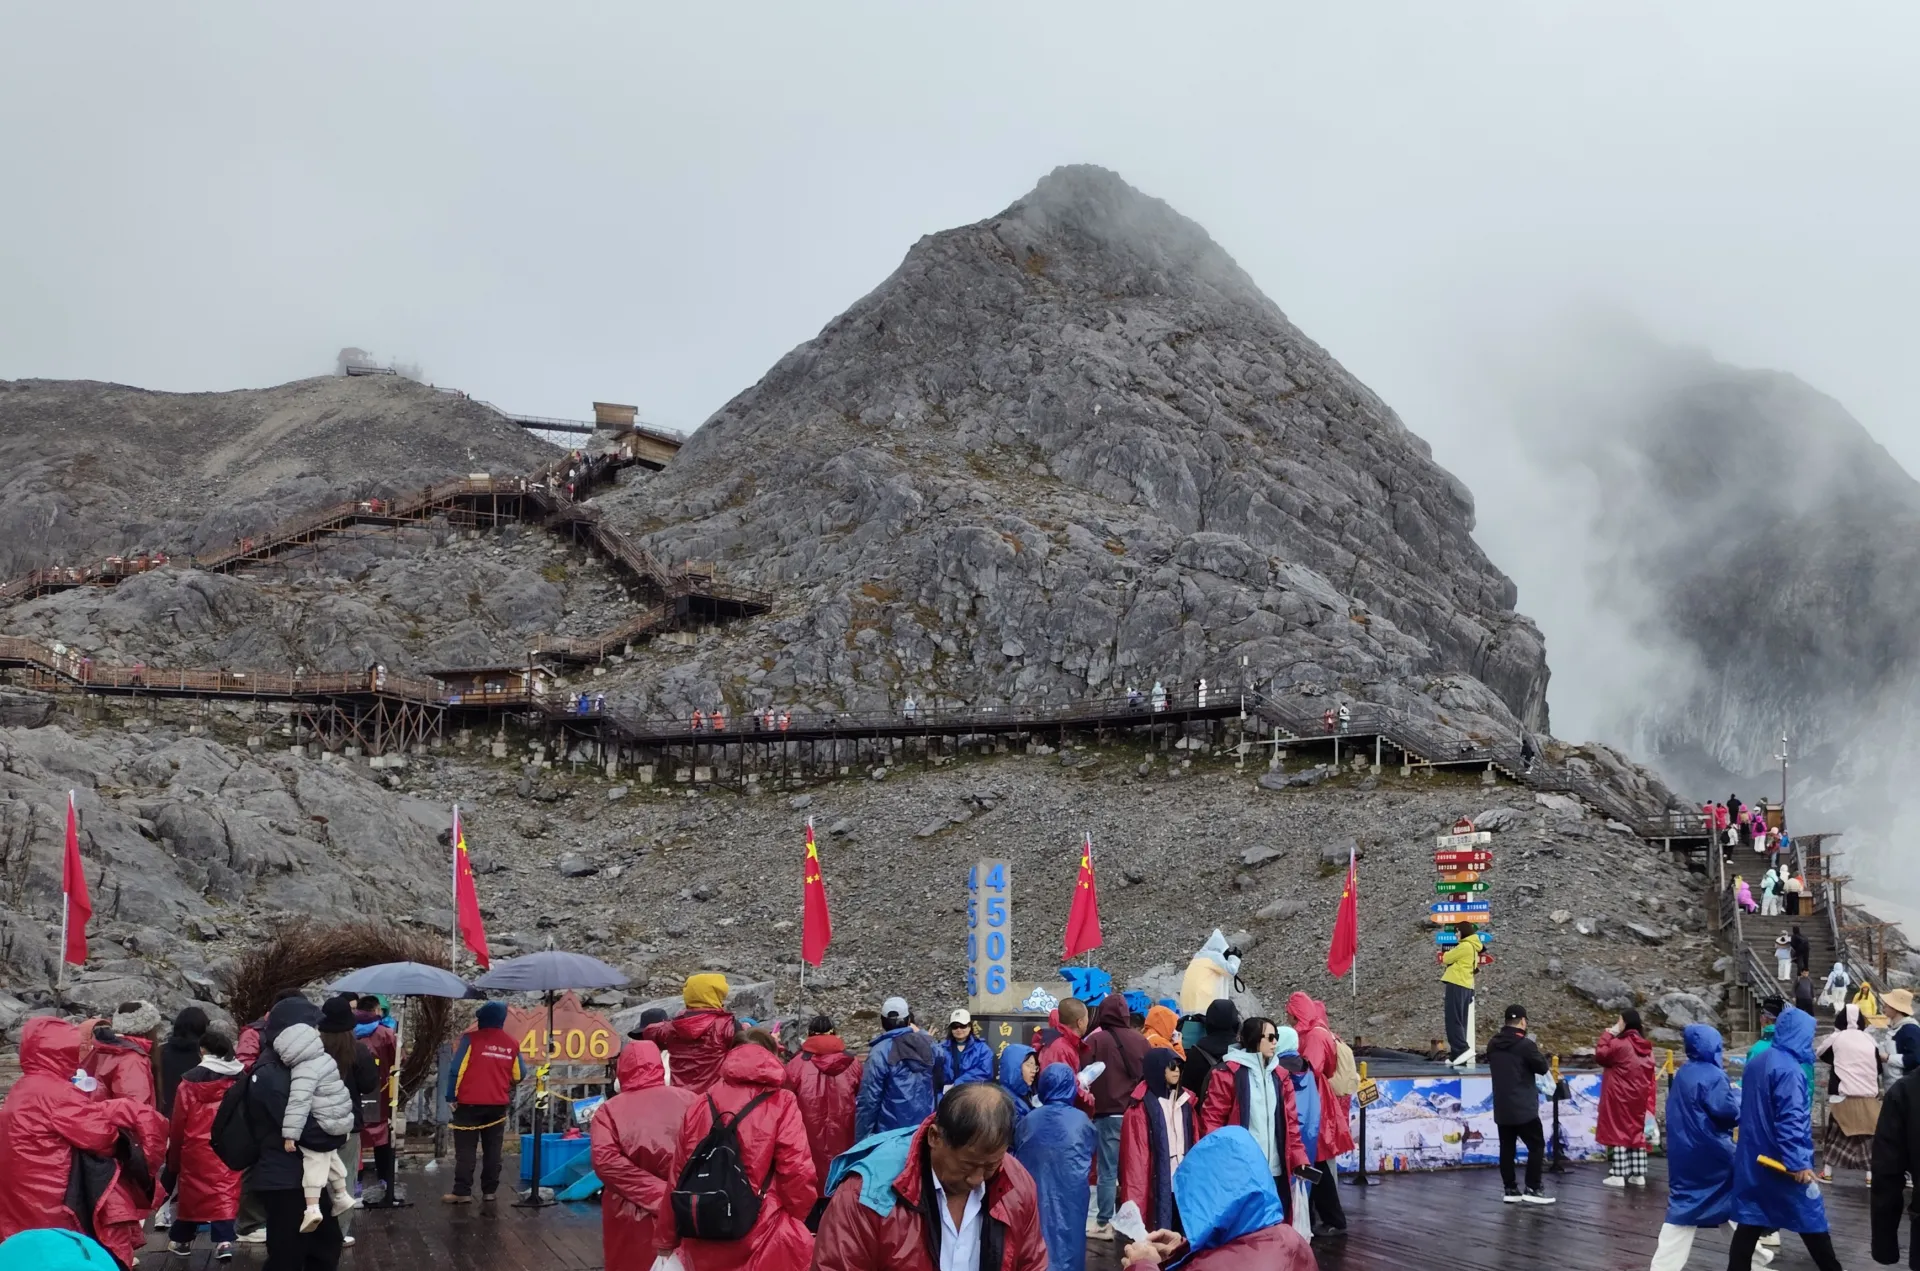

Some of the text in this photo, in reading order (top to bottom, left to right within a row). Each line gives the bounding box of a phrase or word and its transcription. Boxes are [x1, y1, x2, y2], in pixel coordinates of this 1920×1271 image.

[1474, 852, 1486, 860] 北京
[985, 864, 1006, 994] 4506
[520, 1029, 609, 1059] 4506
